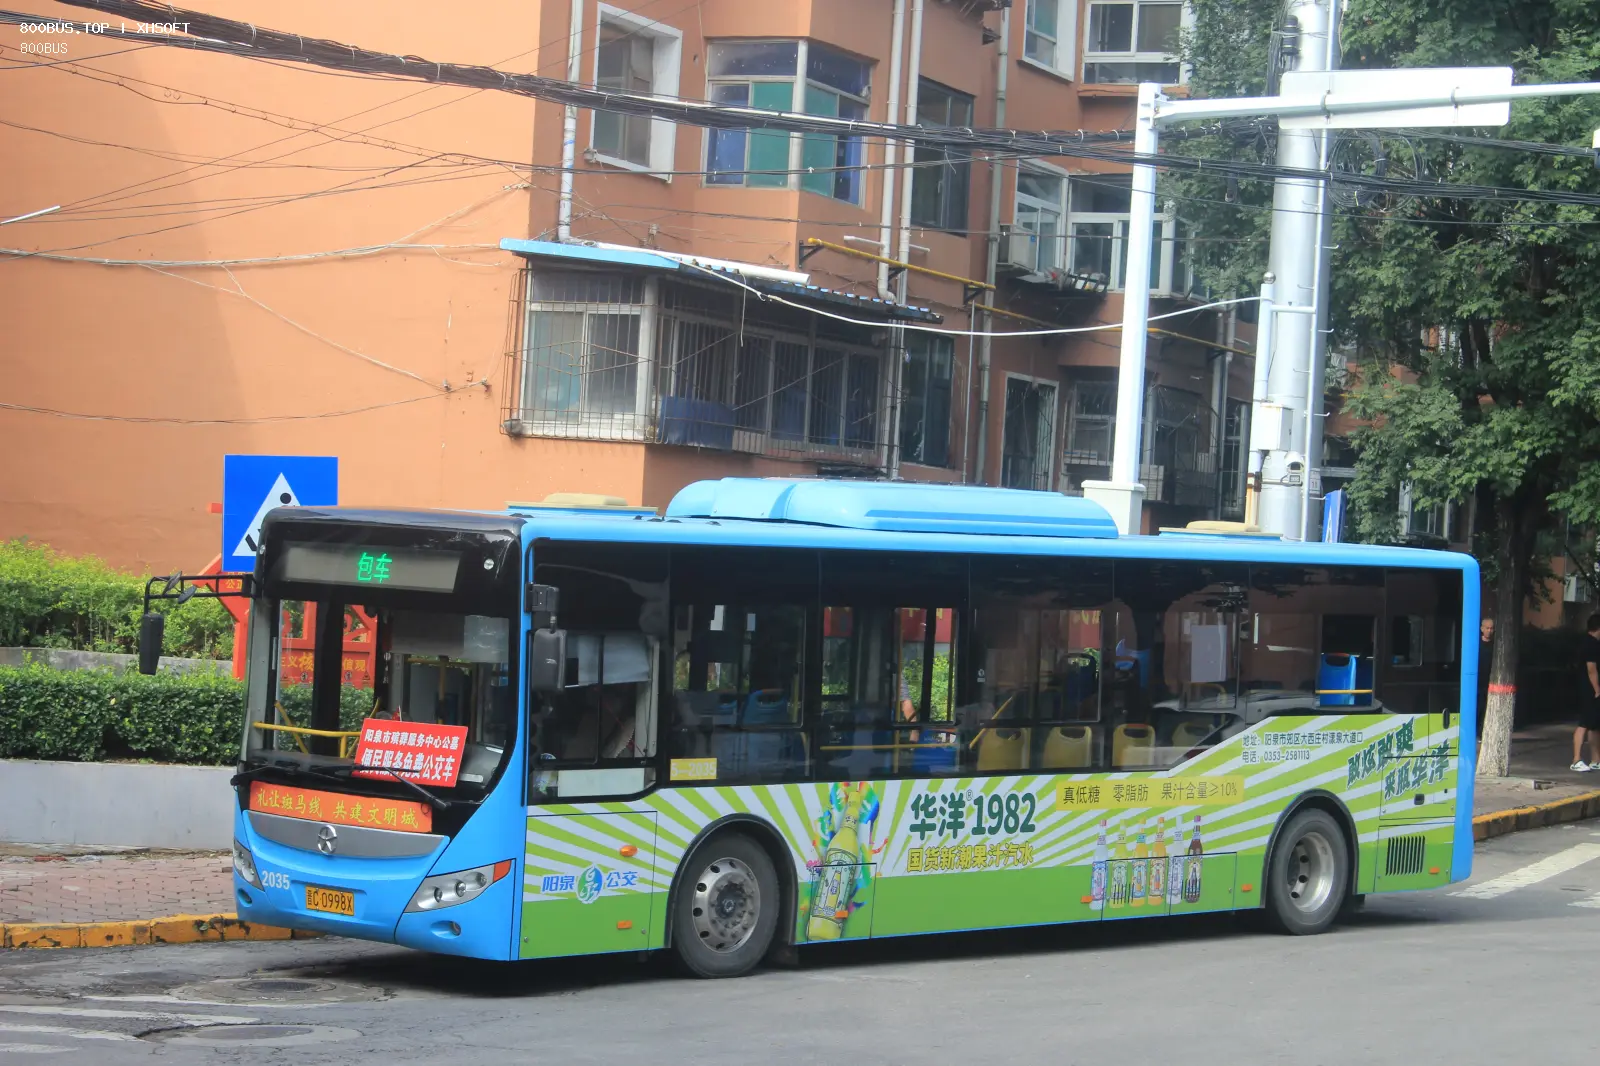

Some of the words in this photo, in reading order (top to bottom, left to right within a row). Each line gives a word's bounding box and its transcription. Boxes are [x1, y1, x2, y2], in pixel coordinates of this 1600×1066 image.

[357, 552, 393, 584] 包车
[364, 728, 460, 751] 阳泉市殡葬服务中心公墓
[359, 748, 456, 782] 便民服务免费公交车
[1384, 738, 1450, 801] 来瓶华洋
[257, 787, 323, 818] 礼让斑马线
[332, 802, 419, 829] 共建文明城
[1063, 785, 1101, 805] 真低糖
[1113, 784, 1149, 802] 零脂肪
[906, 841, 1034, 872] 国货新潮果汁汽水
[262, 870, 290, 890] 2035
[542, 875, 575, 892] 阳泉
[606, 871, 638, 888] 公交
